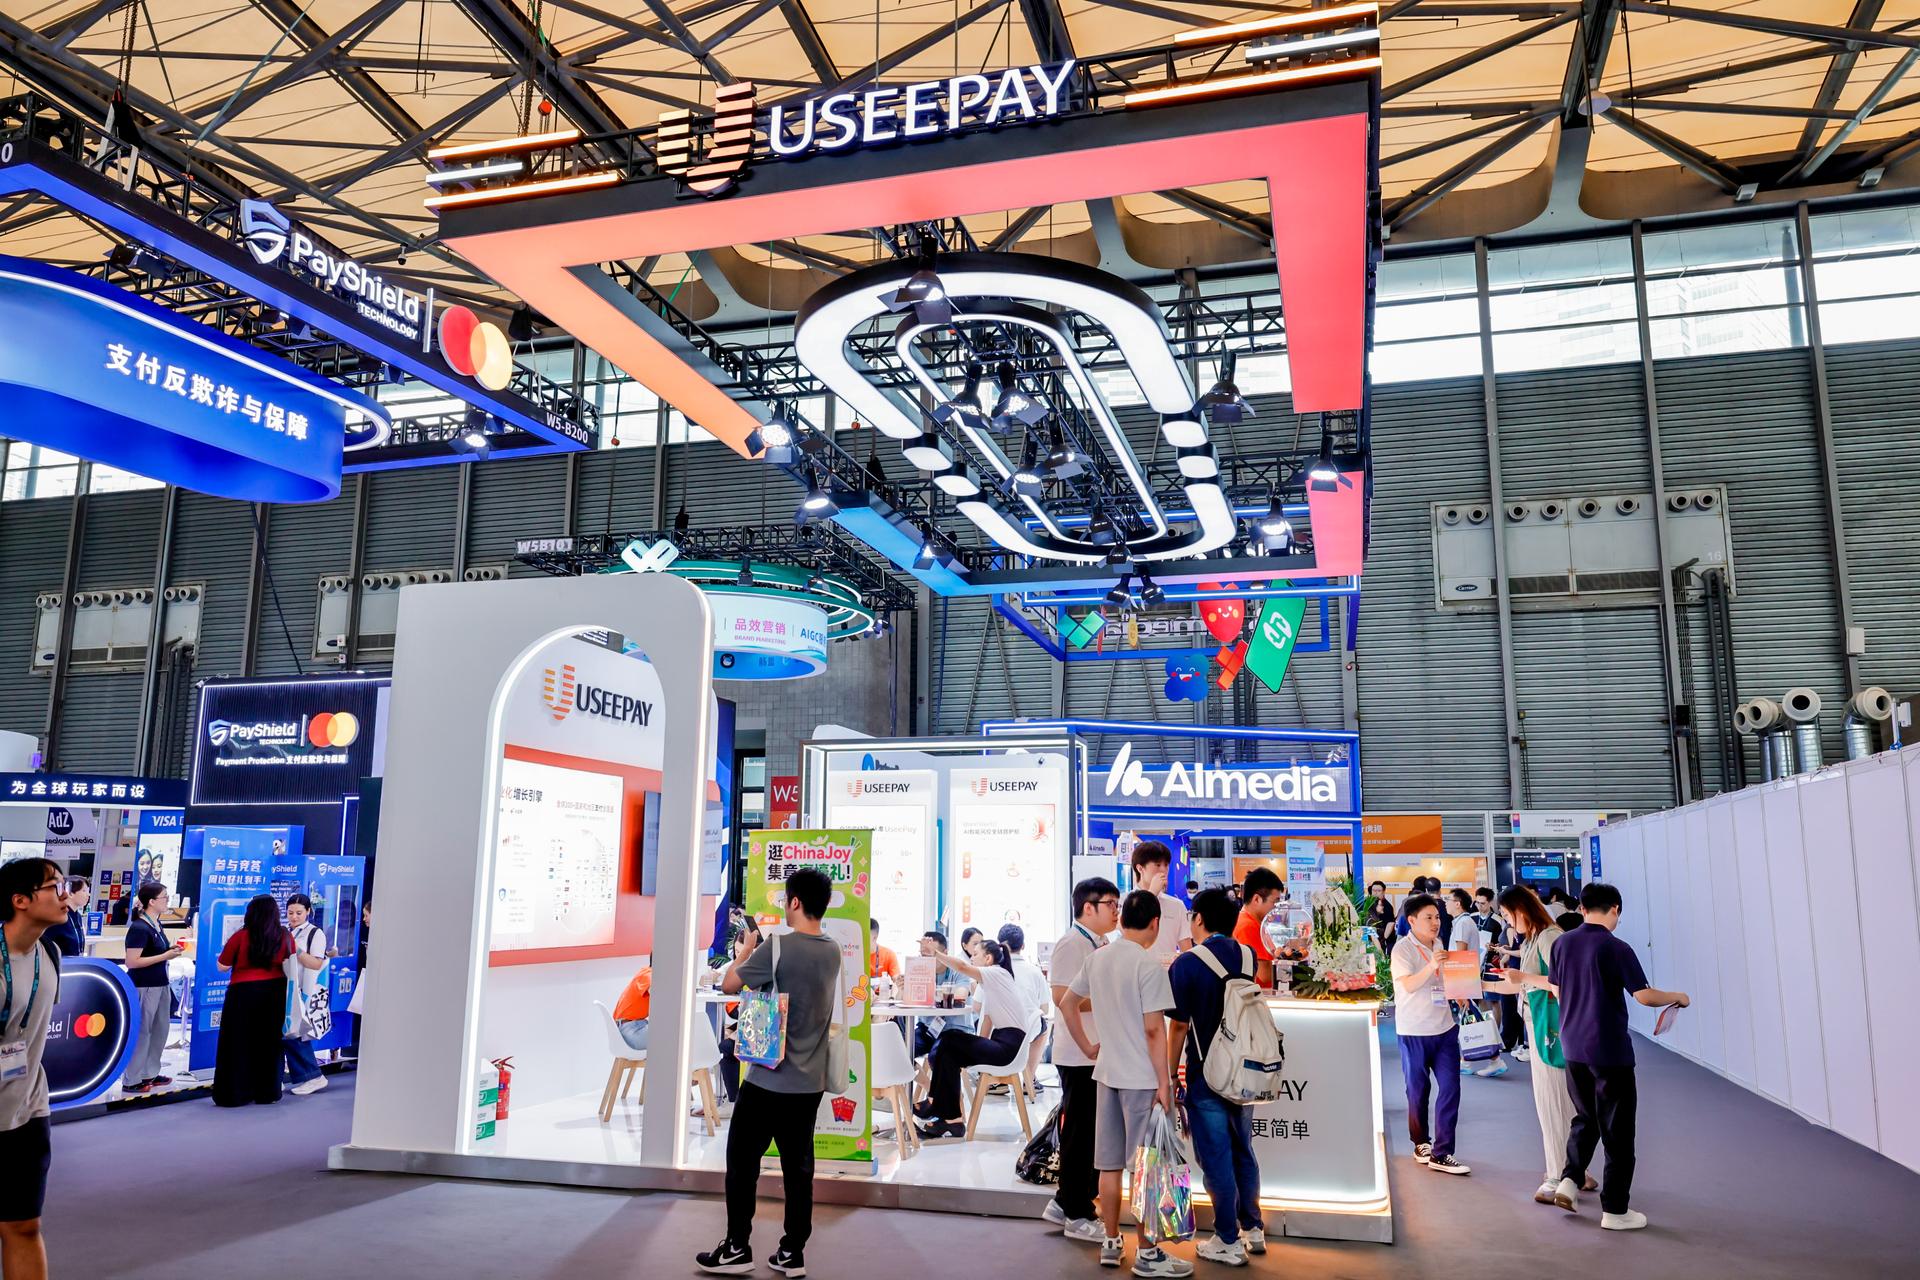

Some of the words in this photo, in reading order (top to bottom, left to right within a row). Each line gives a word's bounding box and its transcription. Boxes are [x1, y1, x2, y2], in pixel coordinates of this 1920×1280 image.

[770, 58, 1076, 155] USEEPAY
[289, 232, 420, 322] PayShield
[357, 302, 418, 340] TECHNOLOGY
[105, 343, 309, 440] 支付反欺诈与保障
[546, 411, 589, 444] W5-B200
[734, 617, 786, 635] 品效营销
[576, 683, 653, 727] USEEPAY
[229, 722, 297, 739] PayShield
[215, 757, 247, 766] Payment
[248, 756, 285, 765] Protection
[11, 780, 146, 799] 为全球玩家而设
[864, 783, 911, 793] USEEPAY
[989, 781, 1038, 792] USEEPAY
[152, 815, 177, 827] VISA
[72, 836, 94, 844] Media
[768, 844, 851, 863] 逛ChinaJoy
[327, 865, 355, 874] PayShield
